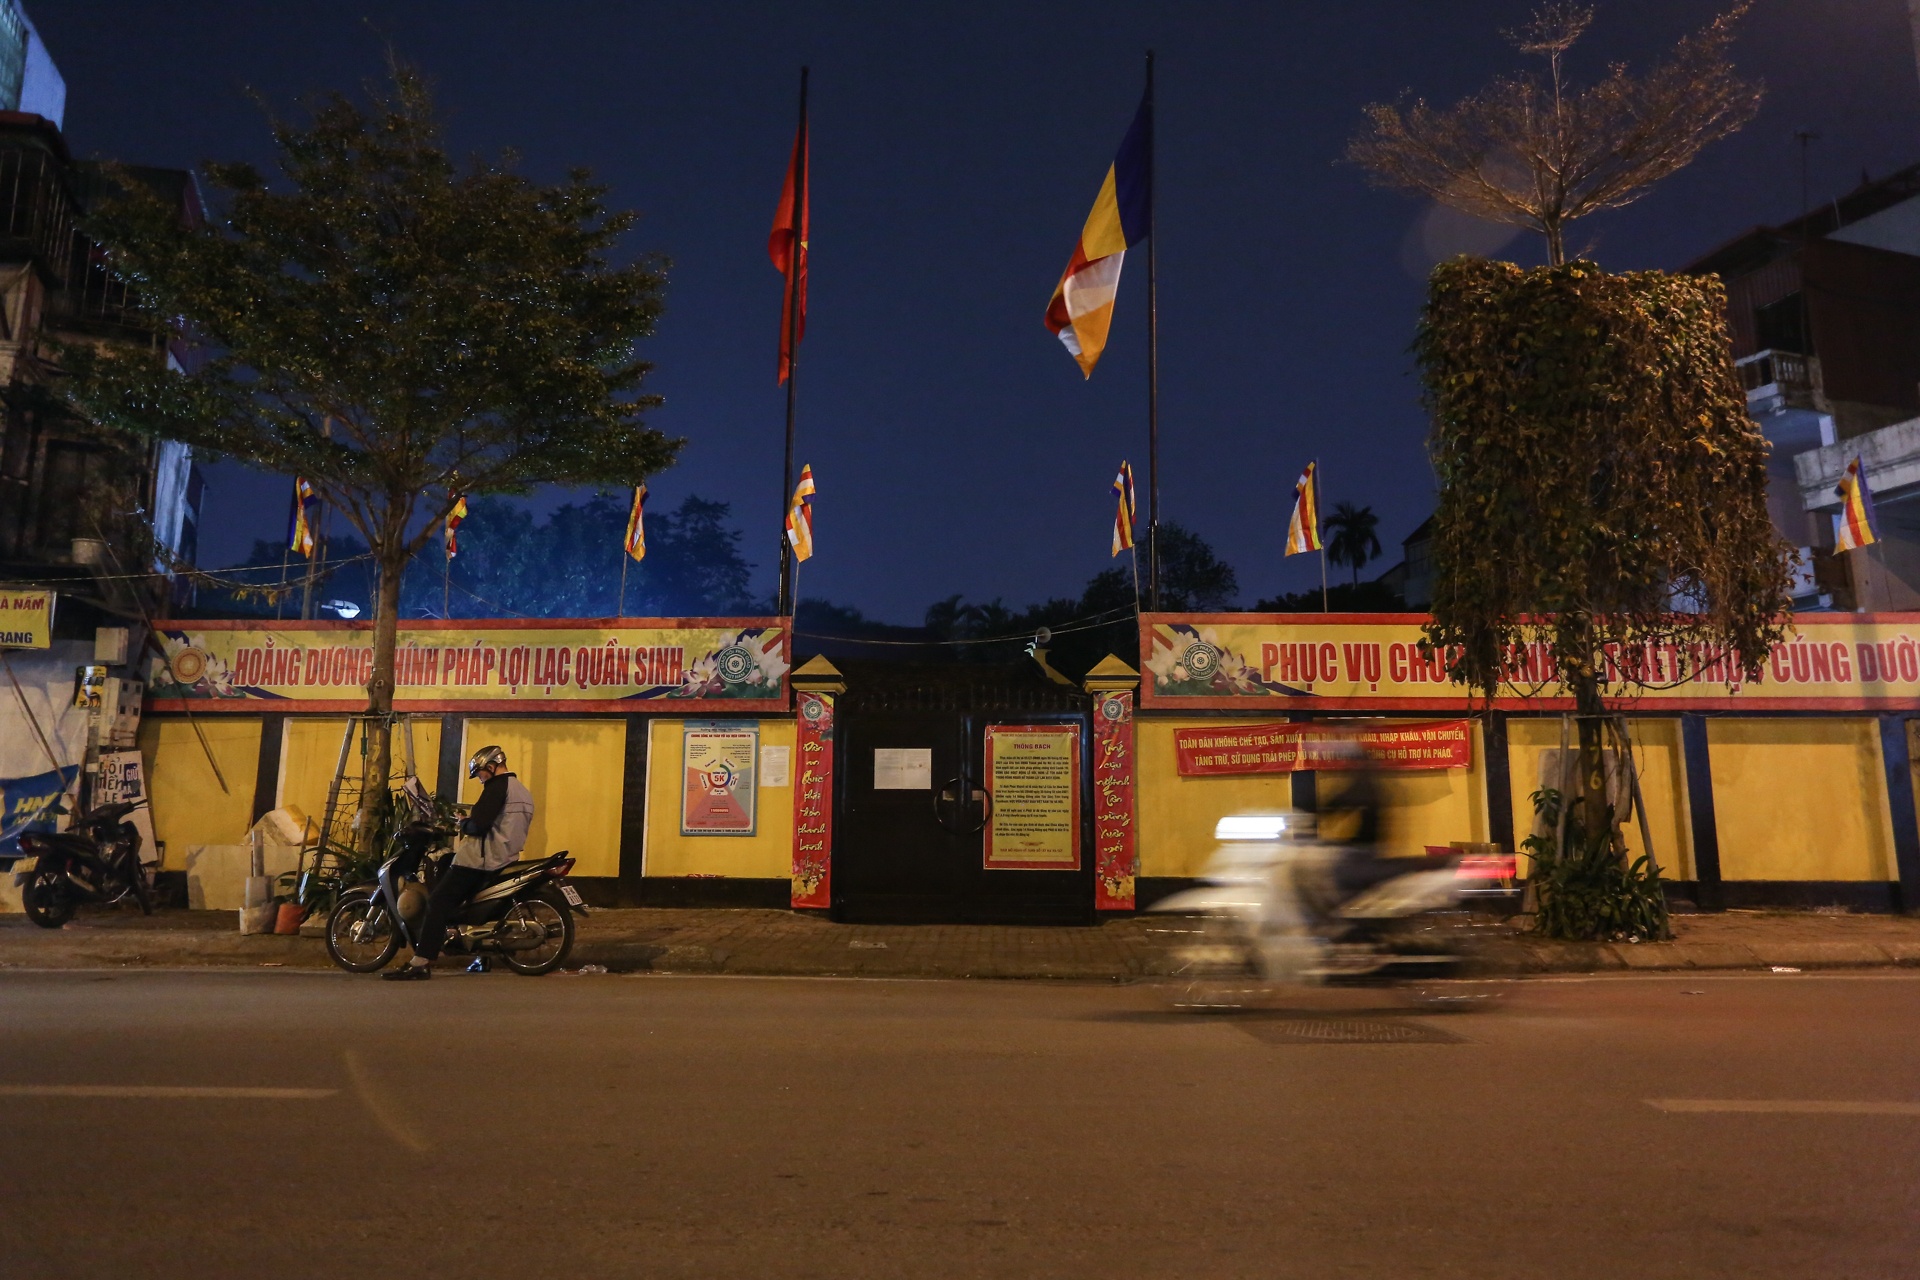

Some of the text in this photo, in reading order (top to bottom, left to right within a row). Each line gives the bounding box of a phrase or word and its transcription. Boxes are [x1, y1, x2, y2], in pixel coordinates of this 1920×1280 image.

[233, 635, 684, 695] HOẰNG DƯƠNG HÍNH PHÁP LỢI LẠC QUẦN SINH
[1261, 642, 1338, 692] PHỤC
[1342, 643, 1382, 692] VỤ
[1770, 635, 1852, 683] CÚNG
[1855, 634, 1920, 683] DƯỜ
[1179, 737, 1198, 749] TOÀN
[1215, 736, 1238, 748] KHÔNG
[1239, 734, 1252, 746] CHẾ
[1254, 736, 1269, 747] TẠO,
[1270, 732, 1284, 744] SẢN
[1380, 732, 1398, 744] NHẬP
[1422, 730, 1436, 743] VẬN
[1195, 754, 1213, 766] TÀNG
[1215, 753, 1230, 765] TRỮ,
[1231, 752, 1240, 764] SỬ
[1242, 754, 1260, 766] DỤNG
[1262, 751, 1277, 762] TRÁI
[1278, 750, 1296, 762] PHÉP
[1398, 746, 1407, 759] HỖ
[1409, 748, 1422, 761] TRỢ
[1423, 746, 1431, 758] VÀ
